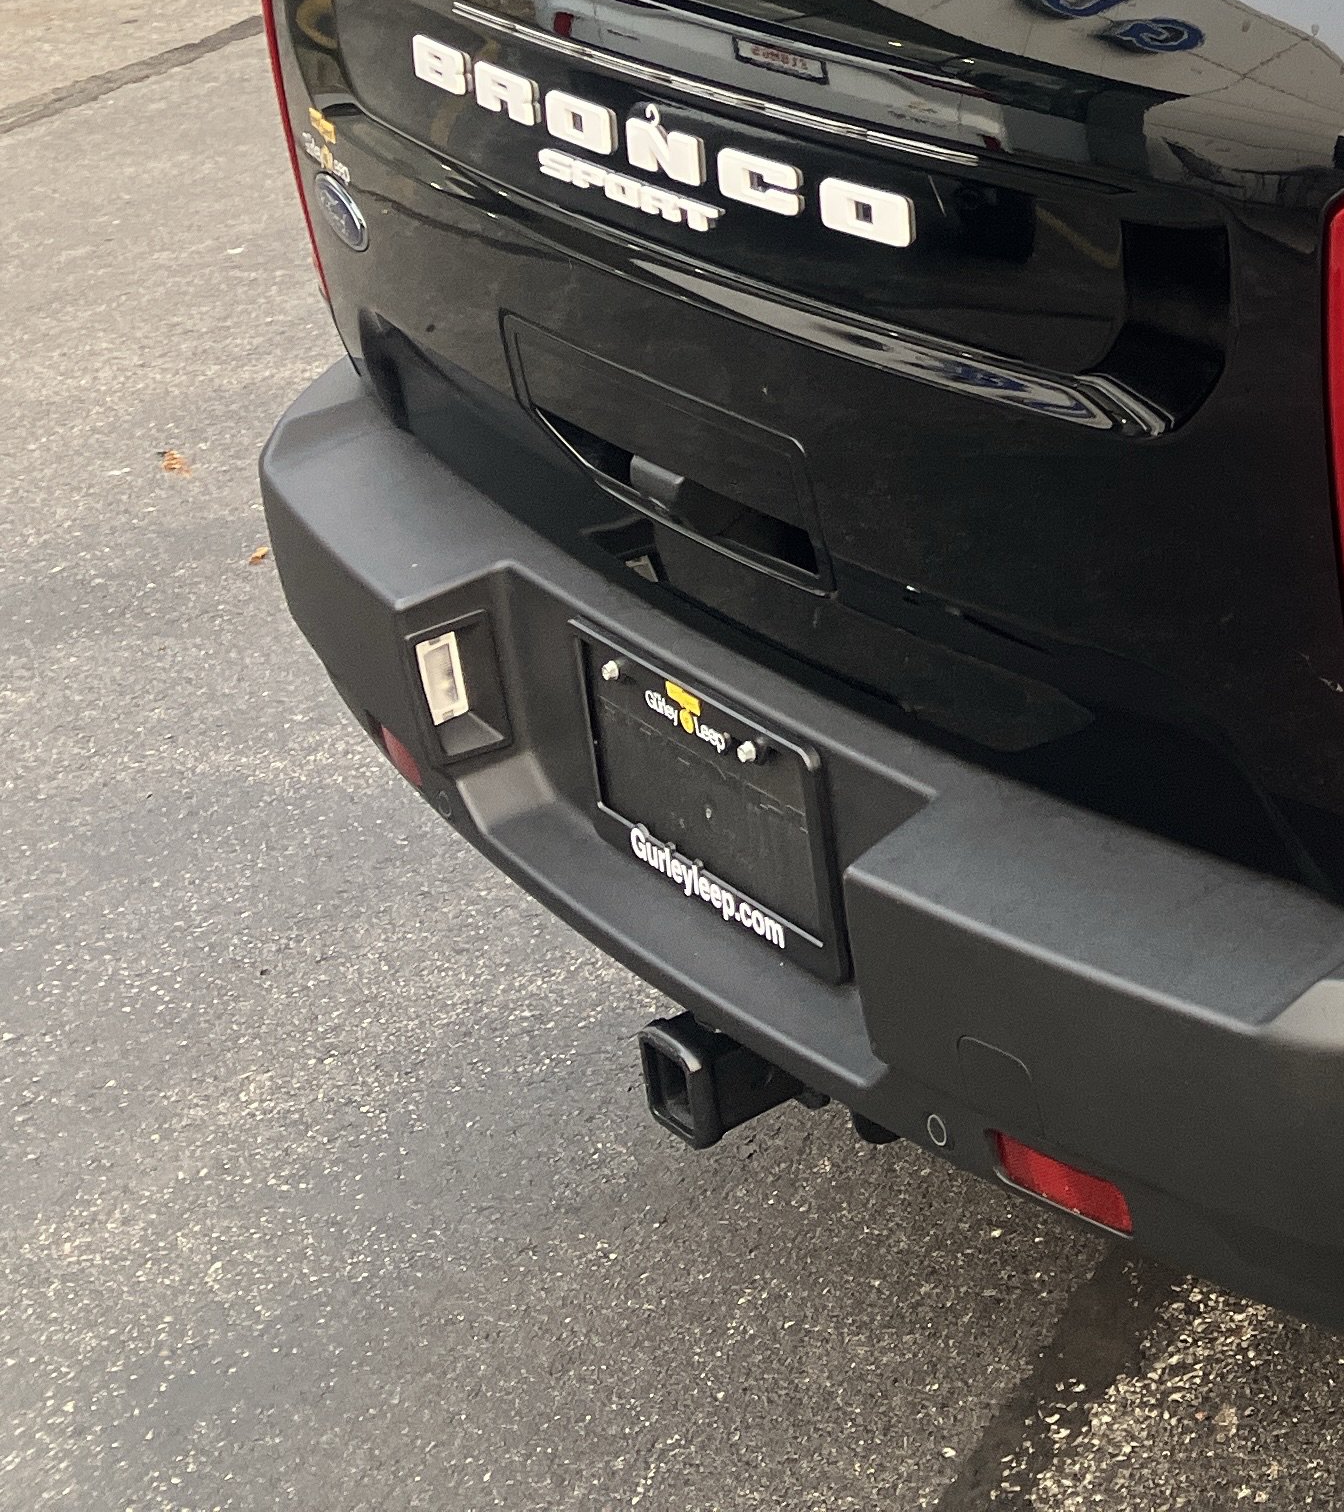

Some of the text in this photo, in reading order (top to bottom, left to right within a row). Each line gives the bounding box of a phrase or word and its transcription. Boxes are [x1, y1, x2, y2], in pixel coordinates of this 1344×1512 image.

[411, 32, 918, 248] BRONCO
[537, 146, 726, 232] SPORT
[630, 826, 786, 949] Gurleyleep.com
